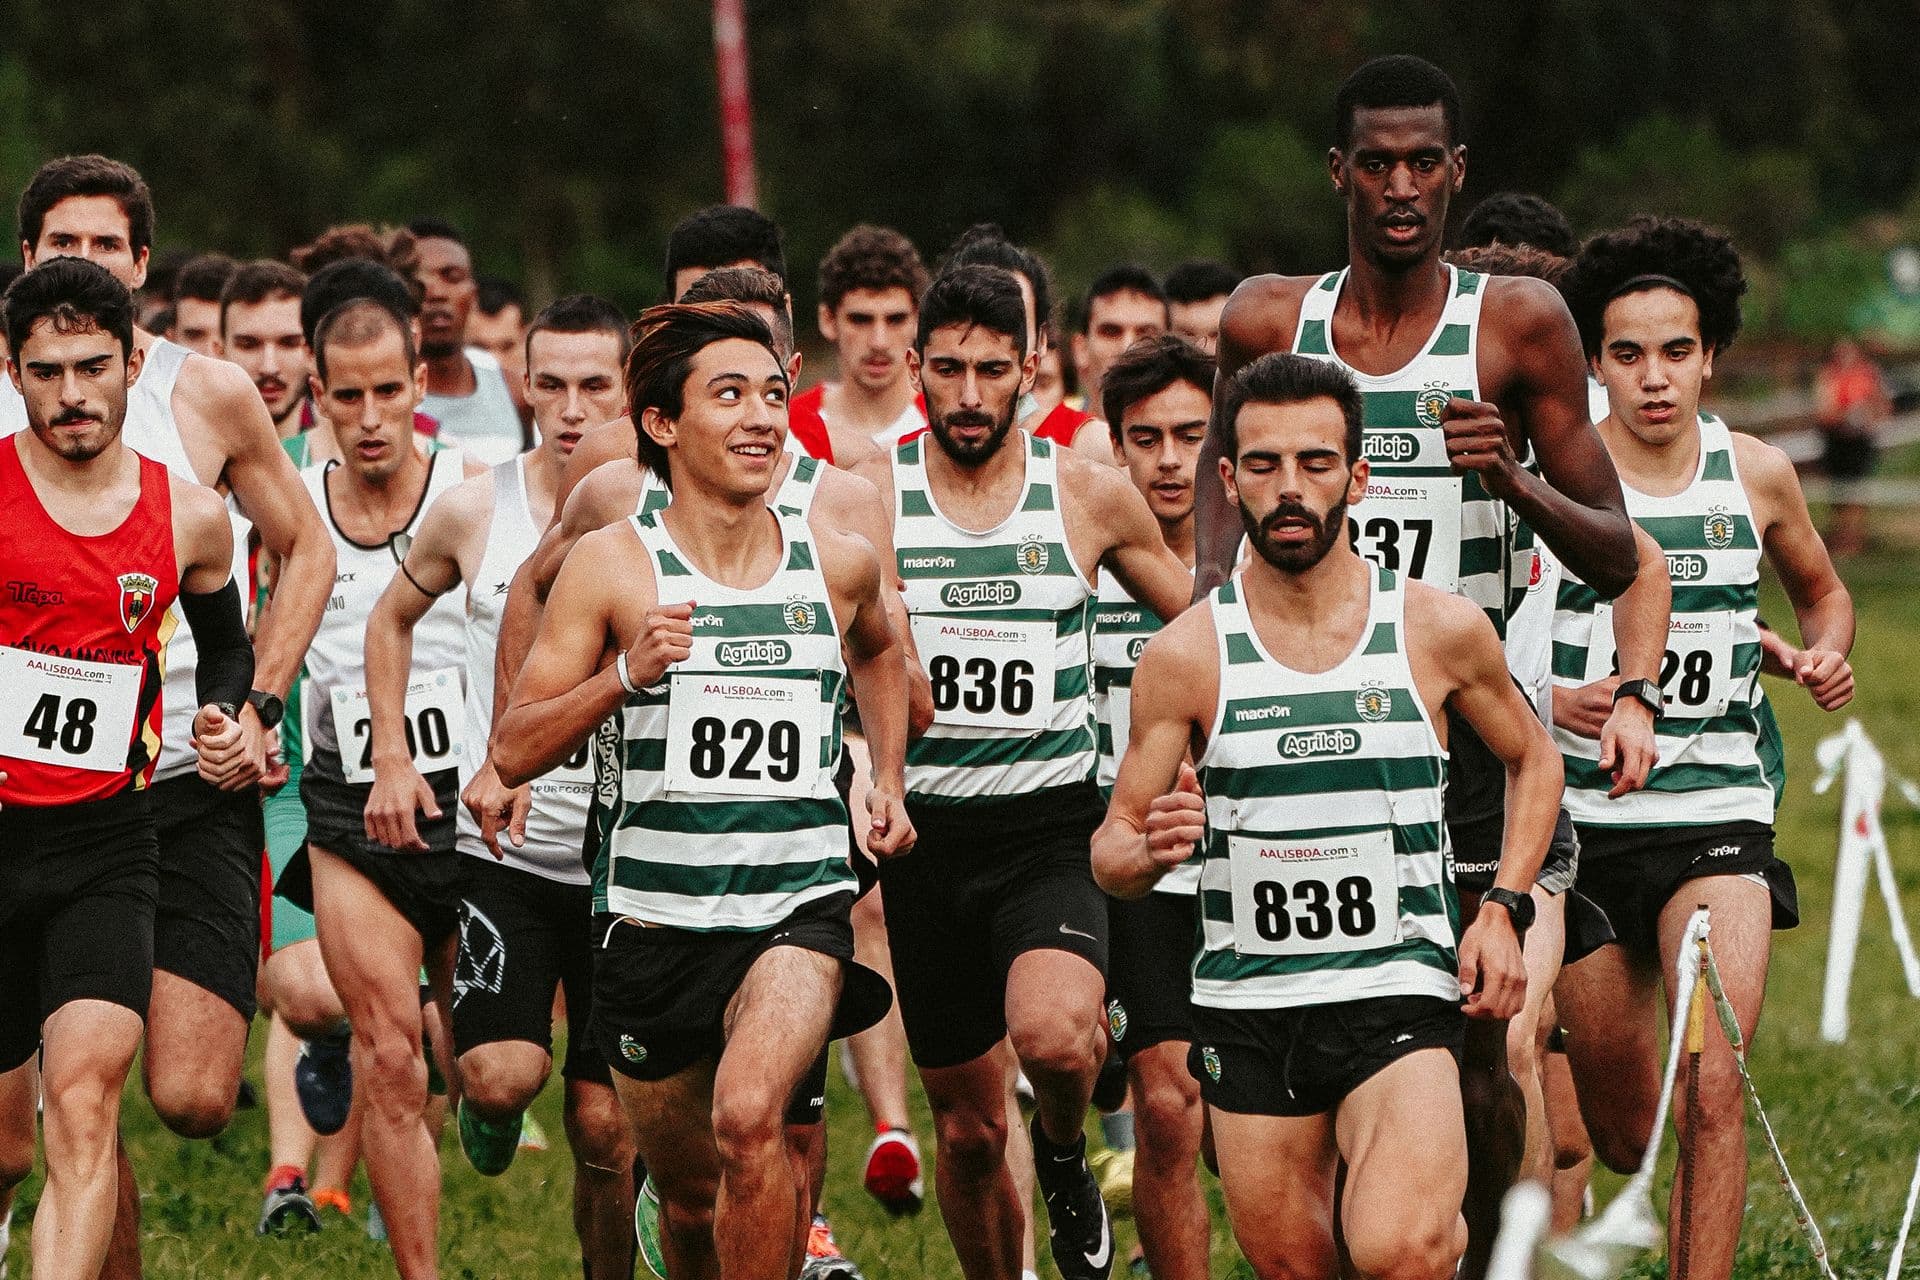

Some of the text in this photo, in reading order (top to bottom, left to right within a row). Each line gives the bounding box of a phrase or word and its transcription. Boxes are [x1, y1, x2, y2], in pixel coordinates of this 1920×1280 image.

[1363, 435, 1413, 460] riloja
[1367, 485, 1418, 496] BOA.com
[903, 556, 957, 569] macron
[1667, 556, 1702, 579] loja
[948, 583, 1014, 606] Agriloja
[940, 626, 1019, 639] AALISBOA.com
[721, 641, 785, 665] Agriloja
[26, 659, 105, 680] AALISBOA.com
[703, 684, 785, 697] AALISBOA.com
[929, 655, 1034, 716] 836
[23, 693, 98, 755] 48
[1235, 705, 1292, 722] macron
[690, 716, 801, 783] 829
[1285, 731, 1355, 757] Agriloja
[1259, 847, 1349, 859] AALISBOA.com
[1456, 860, 1499, 873] macro
[1252, 875, 1376, 942] 838
